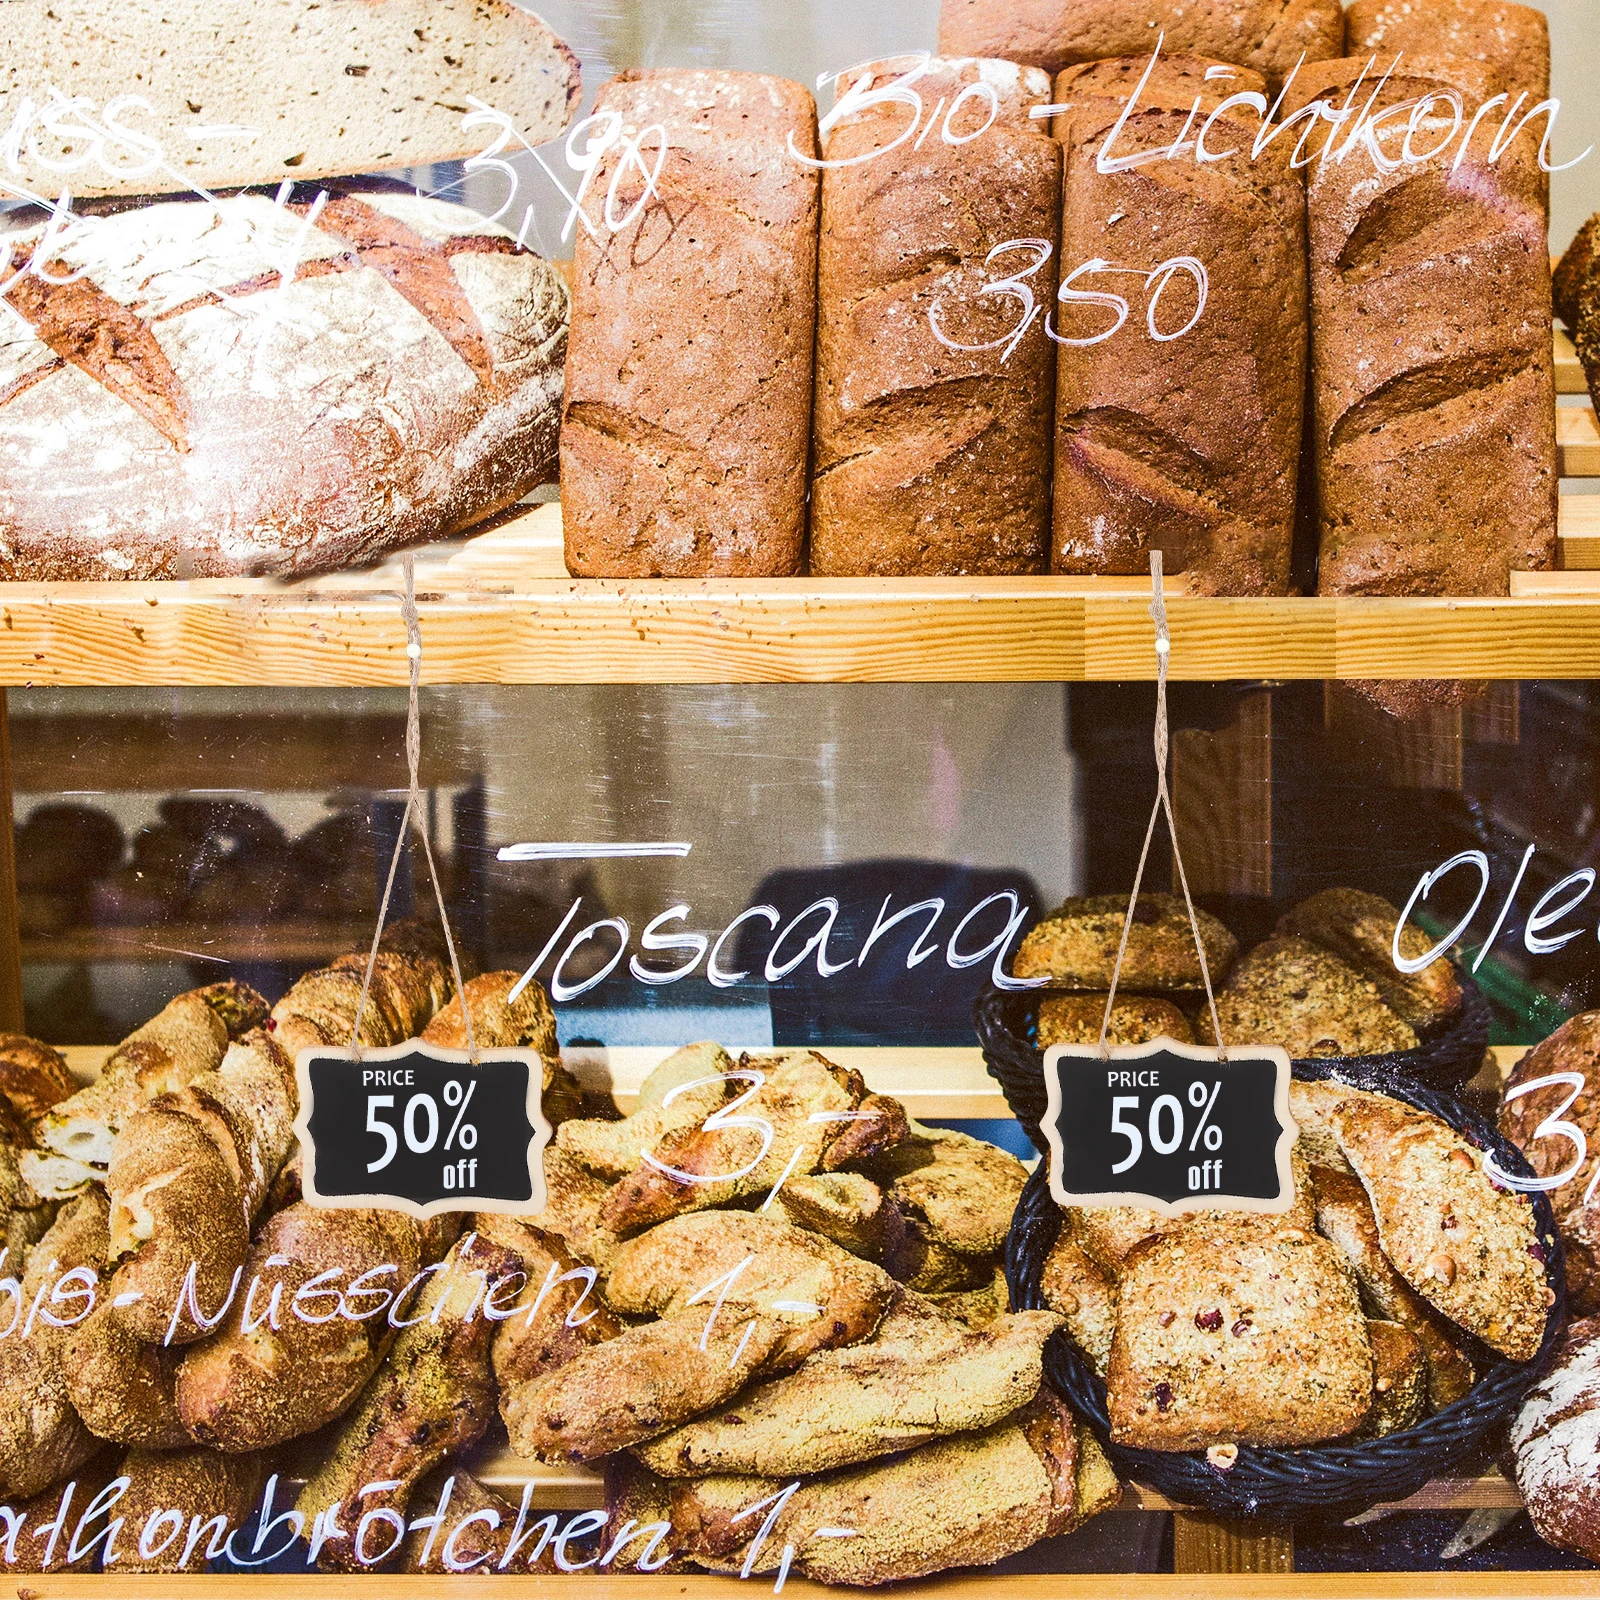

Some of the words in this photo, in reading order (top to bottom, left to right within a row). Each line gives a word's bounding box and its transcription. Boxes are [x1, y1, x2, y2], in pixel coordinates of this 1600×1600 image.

[929, 238, 1208, 364] 3,50
[497, 841, 1052, 1004] Toscana
[1392, 843, 1600, 974] Ole
[363, 1069, 415, 1087] PRICE
[1107, 1070, 1160, 1088] PRICE
[366, 1080, 478, 1173] 50%
[1111, 1081, 1223, 1174] 50%
[443, 1158, 478, 1189] off
[1188, 1159, 1223, 1190] off
